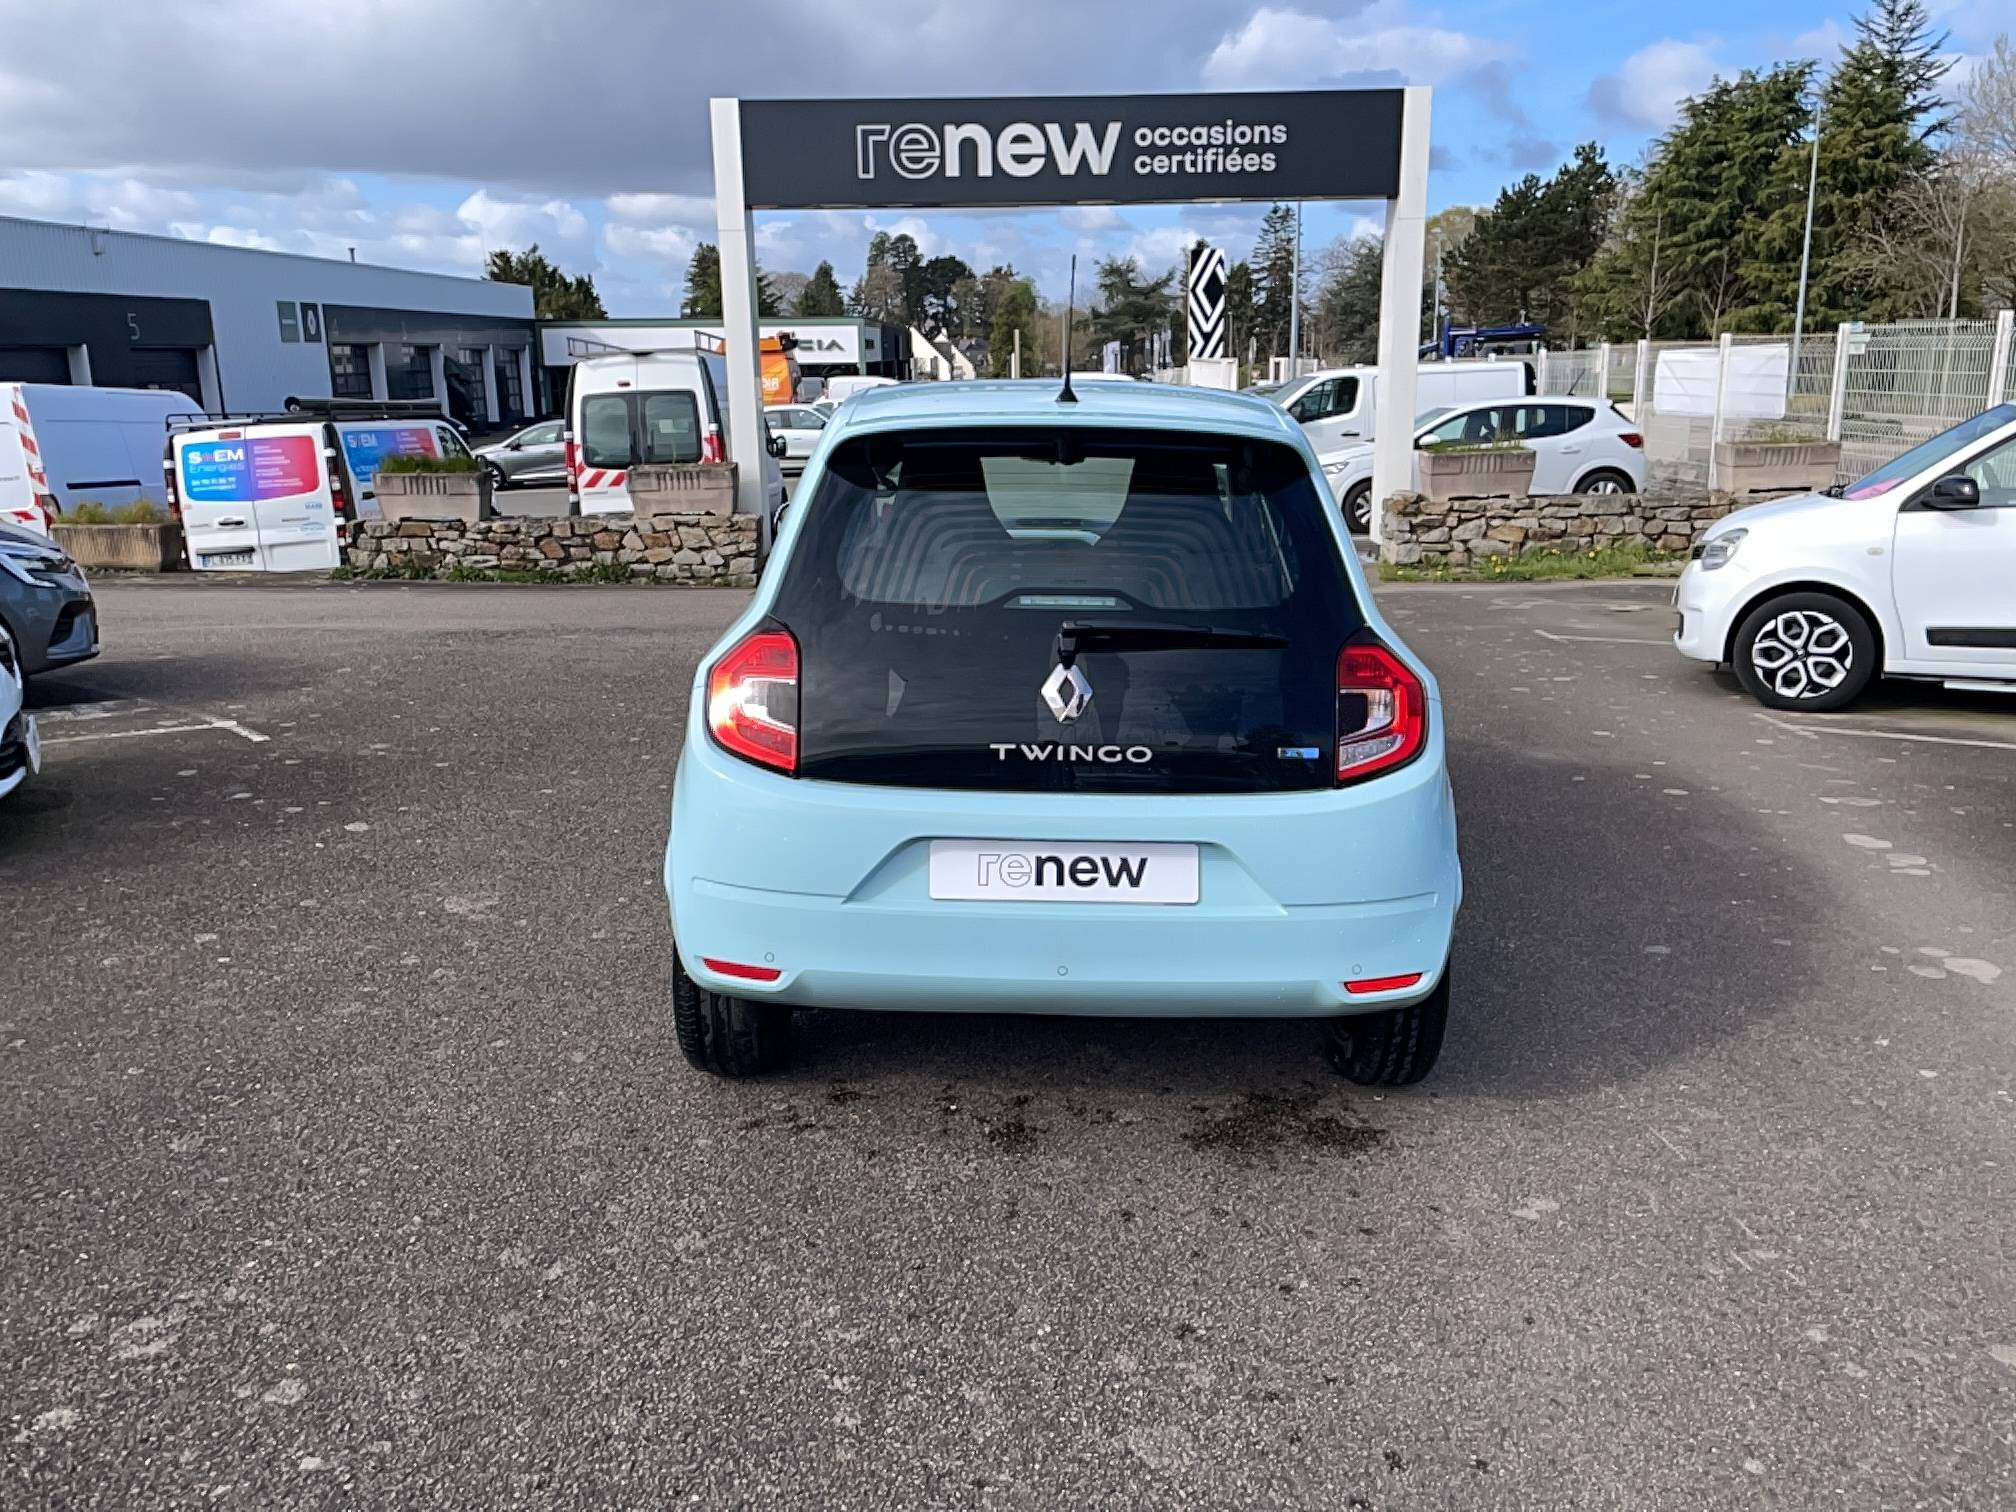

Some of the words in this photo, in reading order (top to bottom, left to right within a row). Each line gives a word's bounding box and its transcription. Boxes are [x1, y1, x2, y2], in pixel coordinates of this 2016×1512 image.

[1134, 120, 1287, 147] occasions
[855, 122, 1122, 180] renew
[1134, 146, 1277, 175] certifiées
[127, 312, 141, 341] 5
[797, 338, 846, 352] CIA
[989, 743, 1153, 763] TWINGO
[977, 853, 1149, 888] renew
